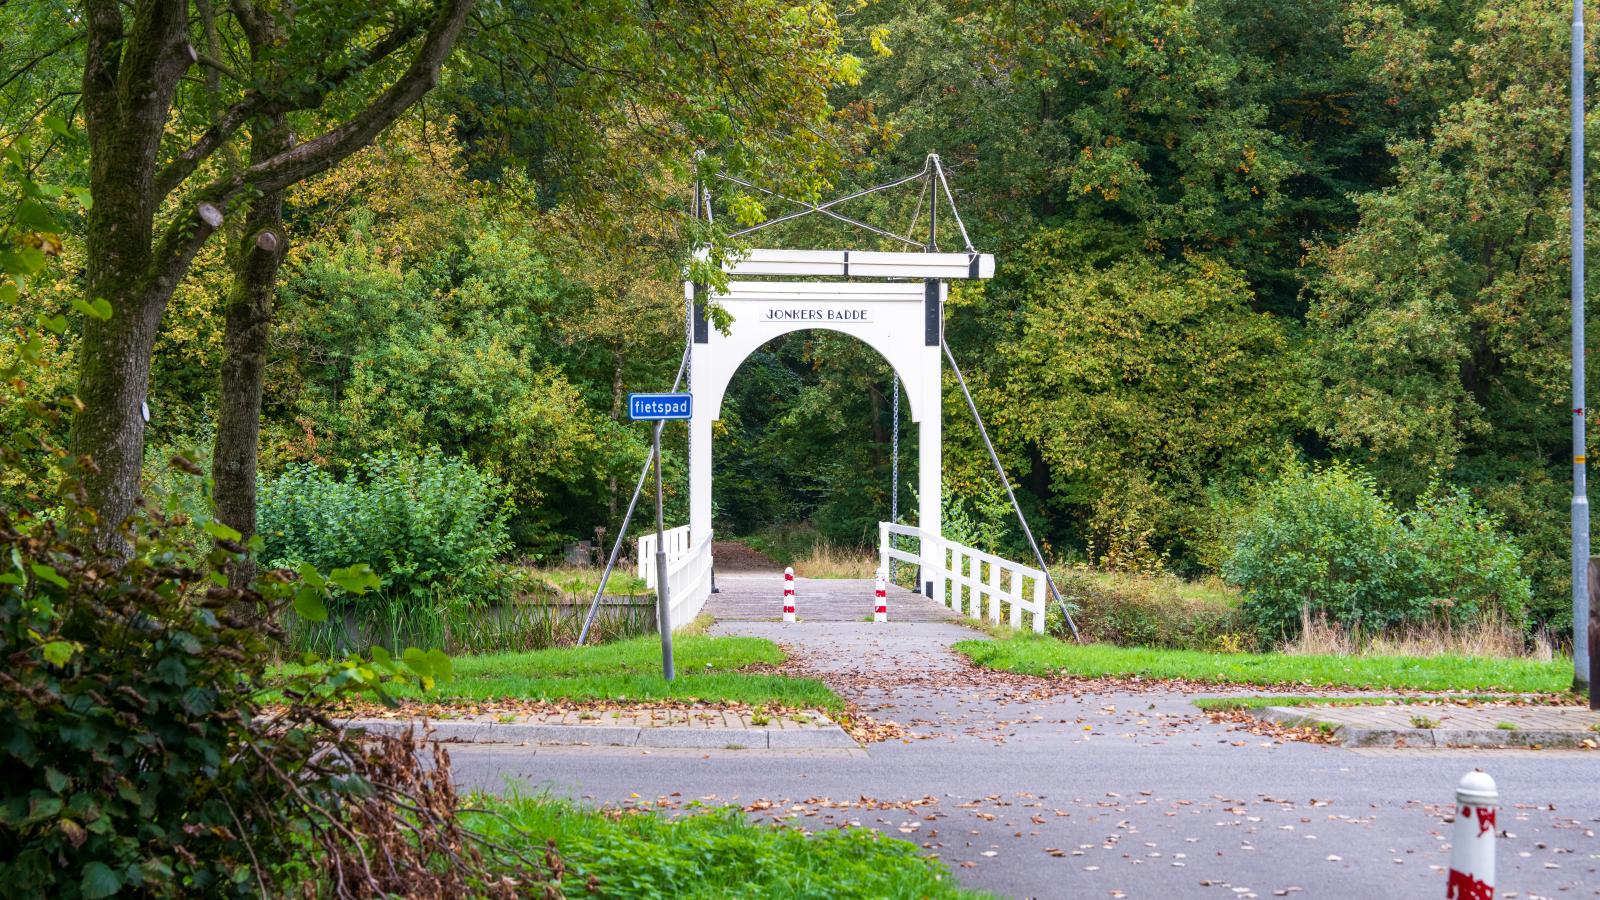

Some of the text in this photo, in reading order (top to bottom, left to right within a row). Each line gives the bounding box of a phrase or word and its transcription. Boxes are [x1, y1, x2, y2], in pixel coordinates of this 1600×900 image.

[766, 309, 868, 320] JONKERS BADDE
[635, 400, 687, 415] fietspad
